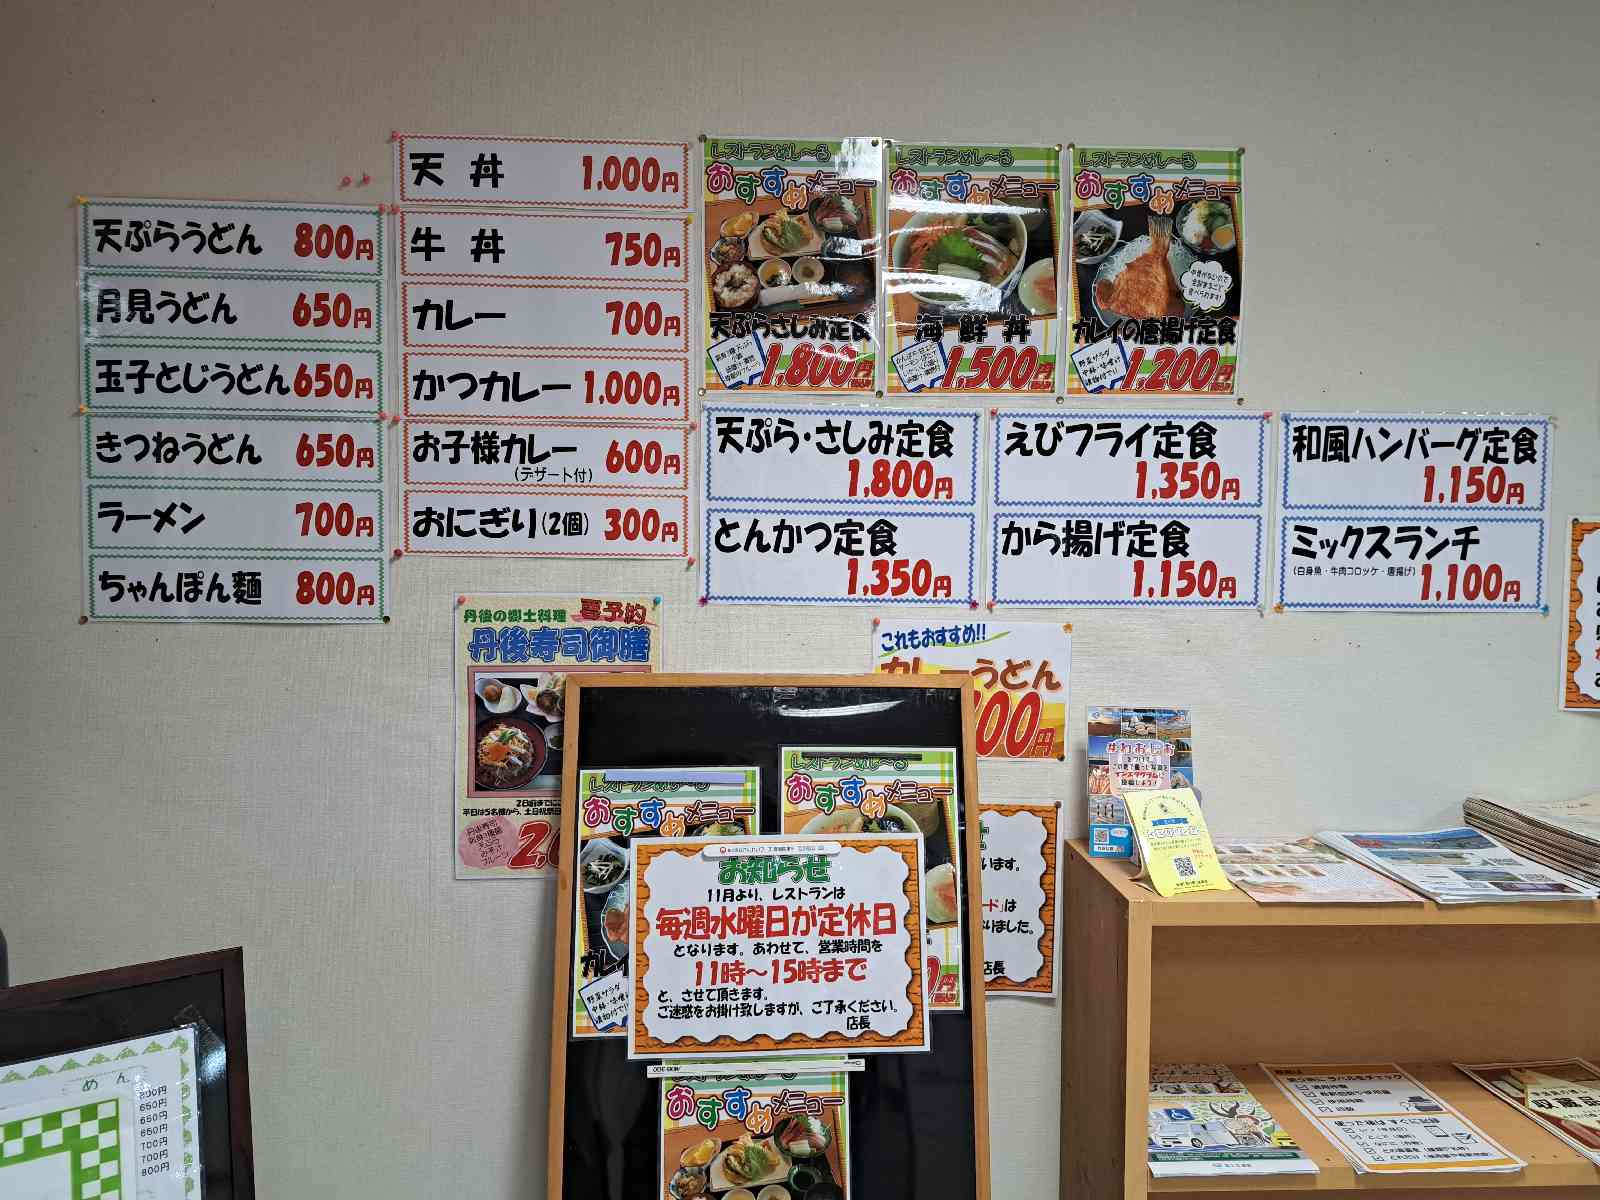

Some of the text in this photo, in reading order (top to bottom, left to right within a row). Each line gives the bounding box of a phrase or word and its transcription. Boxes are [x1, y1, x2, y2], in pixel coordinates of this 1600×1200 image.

[1075, 169, 1241, 215] おすすめメニュー
[93, 219, 374, 260] 天ぷらうどん 800円
[606, 232, 681, 268] 750円
[96, 289, 372, 329] 月見うどん 650円
[412, 299, 681, 336] カレー 700円
[95, 360, 373, 399] 玉子とじうどん 650円
[412, 370, 571, 402] かつカレー
[96, 431, 374, 468] きつねうどん 650円
[412, 430, 681, 474] お子様カレー 600円
[715, 416, 954, 458] 天ぷら・さしみ定食
[1004, 421, 1217, 459] えびフライ定食
[1292, 425, 1538, 464] 和風ハンバーグ定食
[848, 458, 953, 500] 1,800円
[1136, 460, 1240, 500] 1,350円
[98, 502, 373, 537] ラーメン 700円
[604, 508, 679, 542] 300円
[714, 518, 898, 557] とんかつ定食
[1001, 520, 1190, 558] から揚げ定食
[1291, 525, 1480, 560] ミックスランチ
[99, 570, 375, 606] ちゃんぽん麺 800円
[847, 558, 952, 598] 1,350円
[463, 608, 568, 624] 丹後の郷土料理
[468, 626, 650, 663] 丹後寿司御膳
[881, 623, 986, 651] これもおすすめ!!
[786, 772, 953, 819] おすすめメニュー
[707, 887, 846, 902] 11月より、レストランは
[656, 903, 897, 940] 毎週水曜日が定休日
[657, 987, 768, 1003] と、させて頂きます。
[847, 1016, 871, 1030] 店長
[666, 1085, 845, 1134] おすすめメニュー
